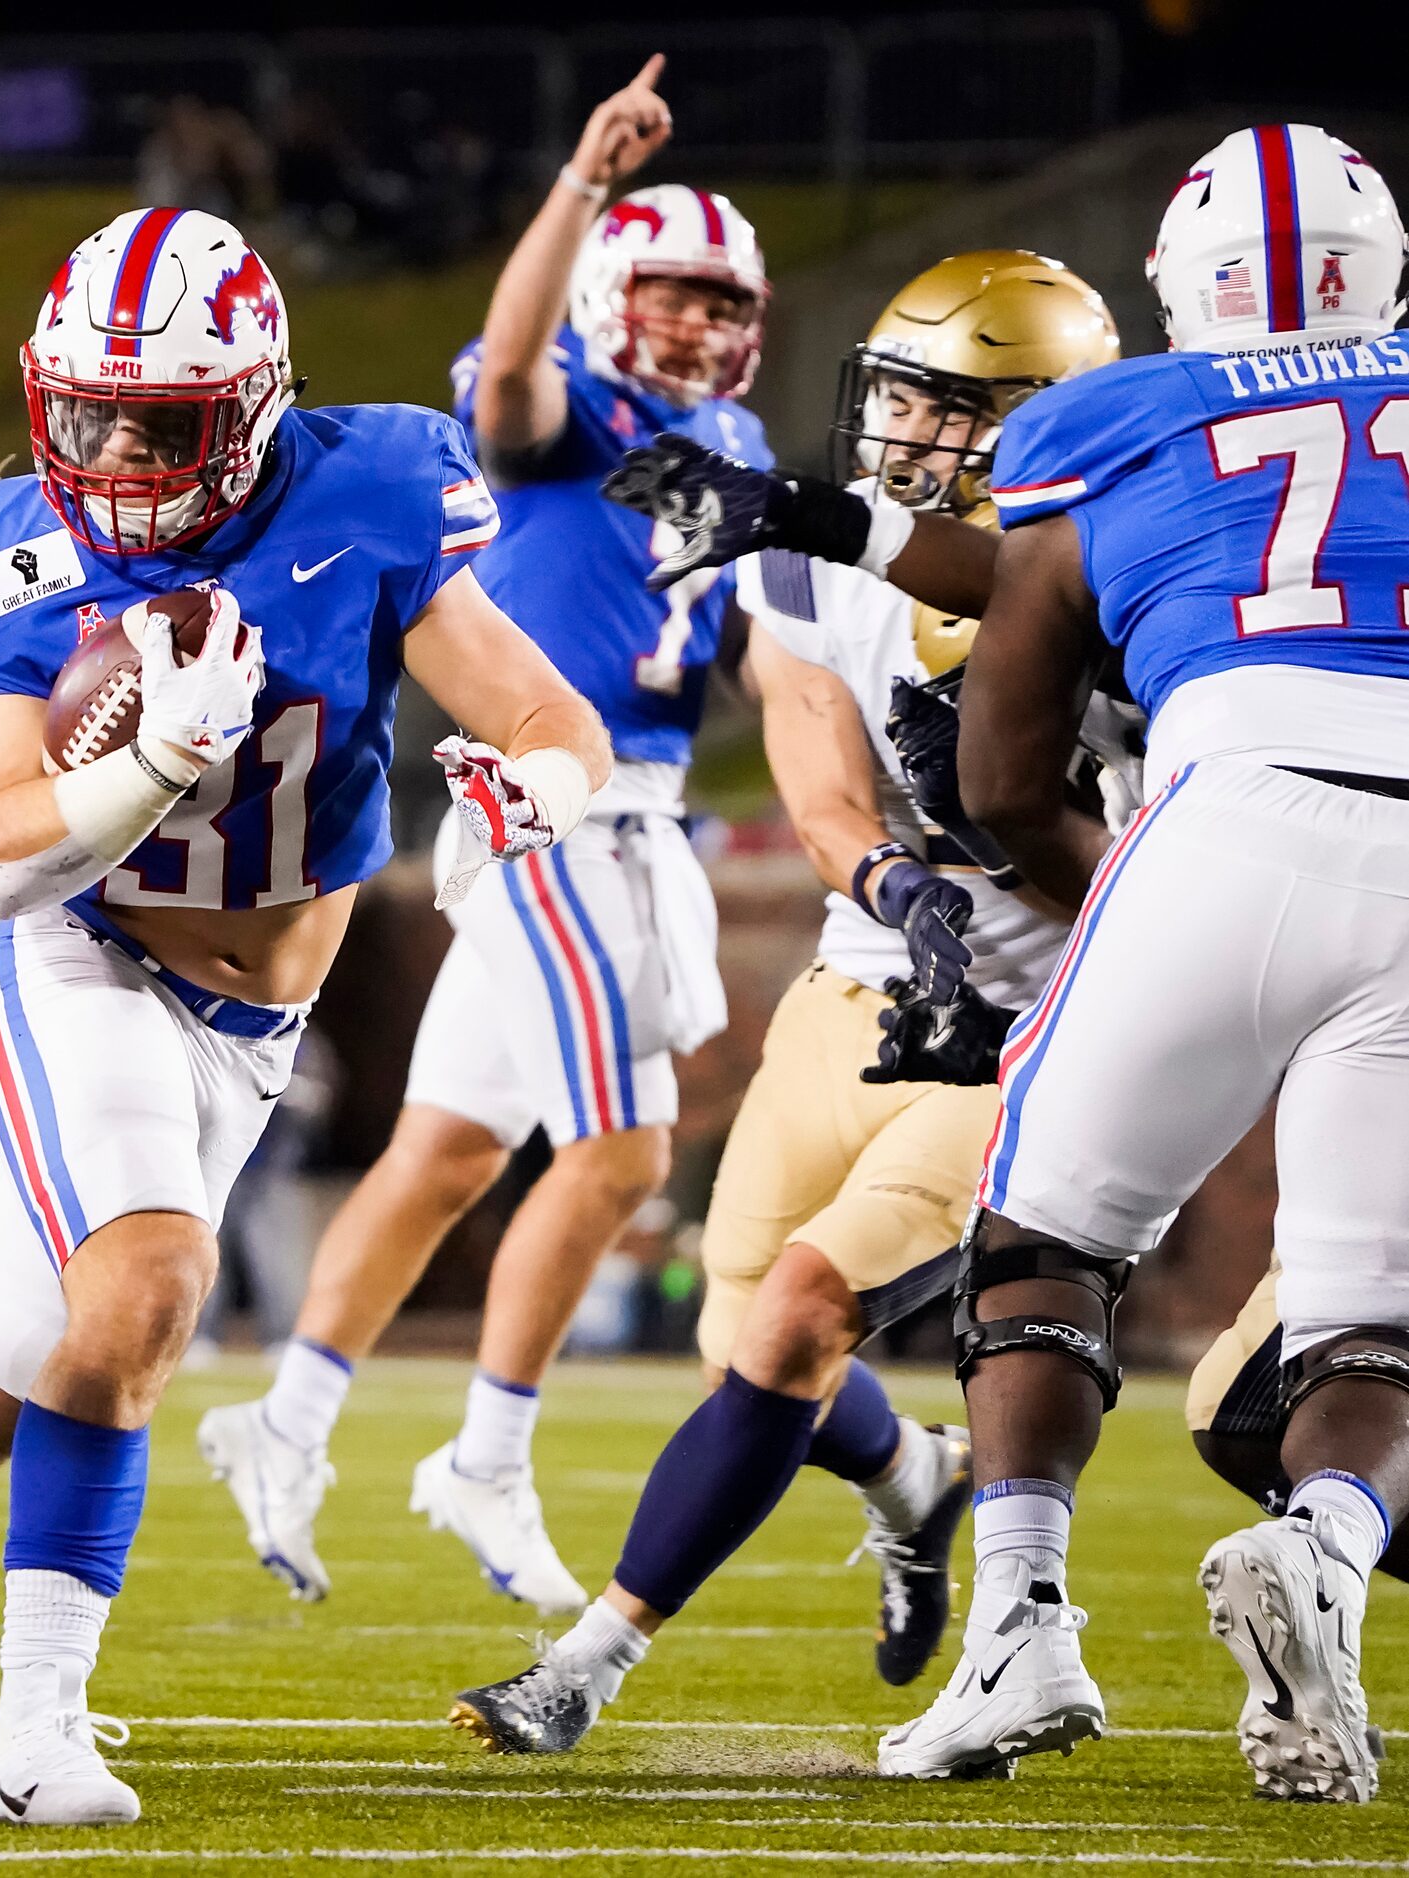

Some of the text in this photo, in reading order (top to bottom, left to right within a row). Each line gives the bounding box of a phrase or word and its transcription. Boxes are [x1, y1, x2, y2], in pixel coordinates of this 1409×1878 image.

[1321, 295, 1340, 310] P6
[1306, 336, 1362, 353] TAYLOR
[99, 360, 143, 380] SMU
[1212, 335, 1409, 398] THOMAS
[2, 575, 72, 611] GREAT FAMILY
[103, 697, 326, 912] 31
[1024, 1324, 1101, 1351] DONJOY
